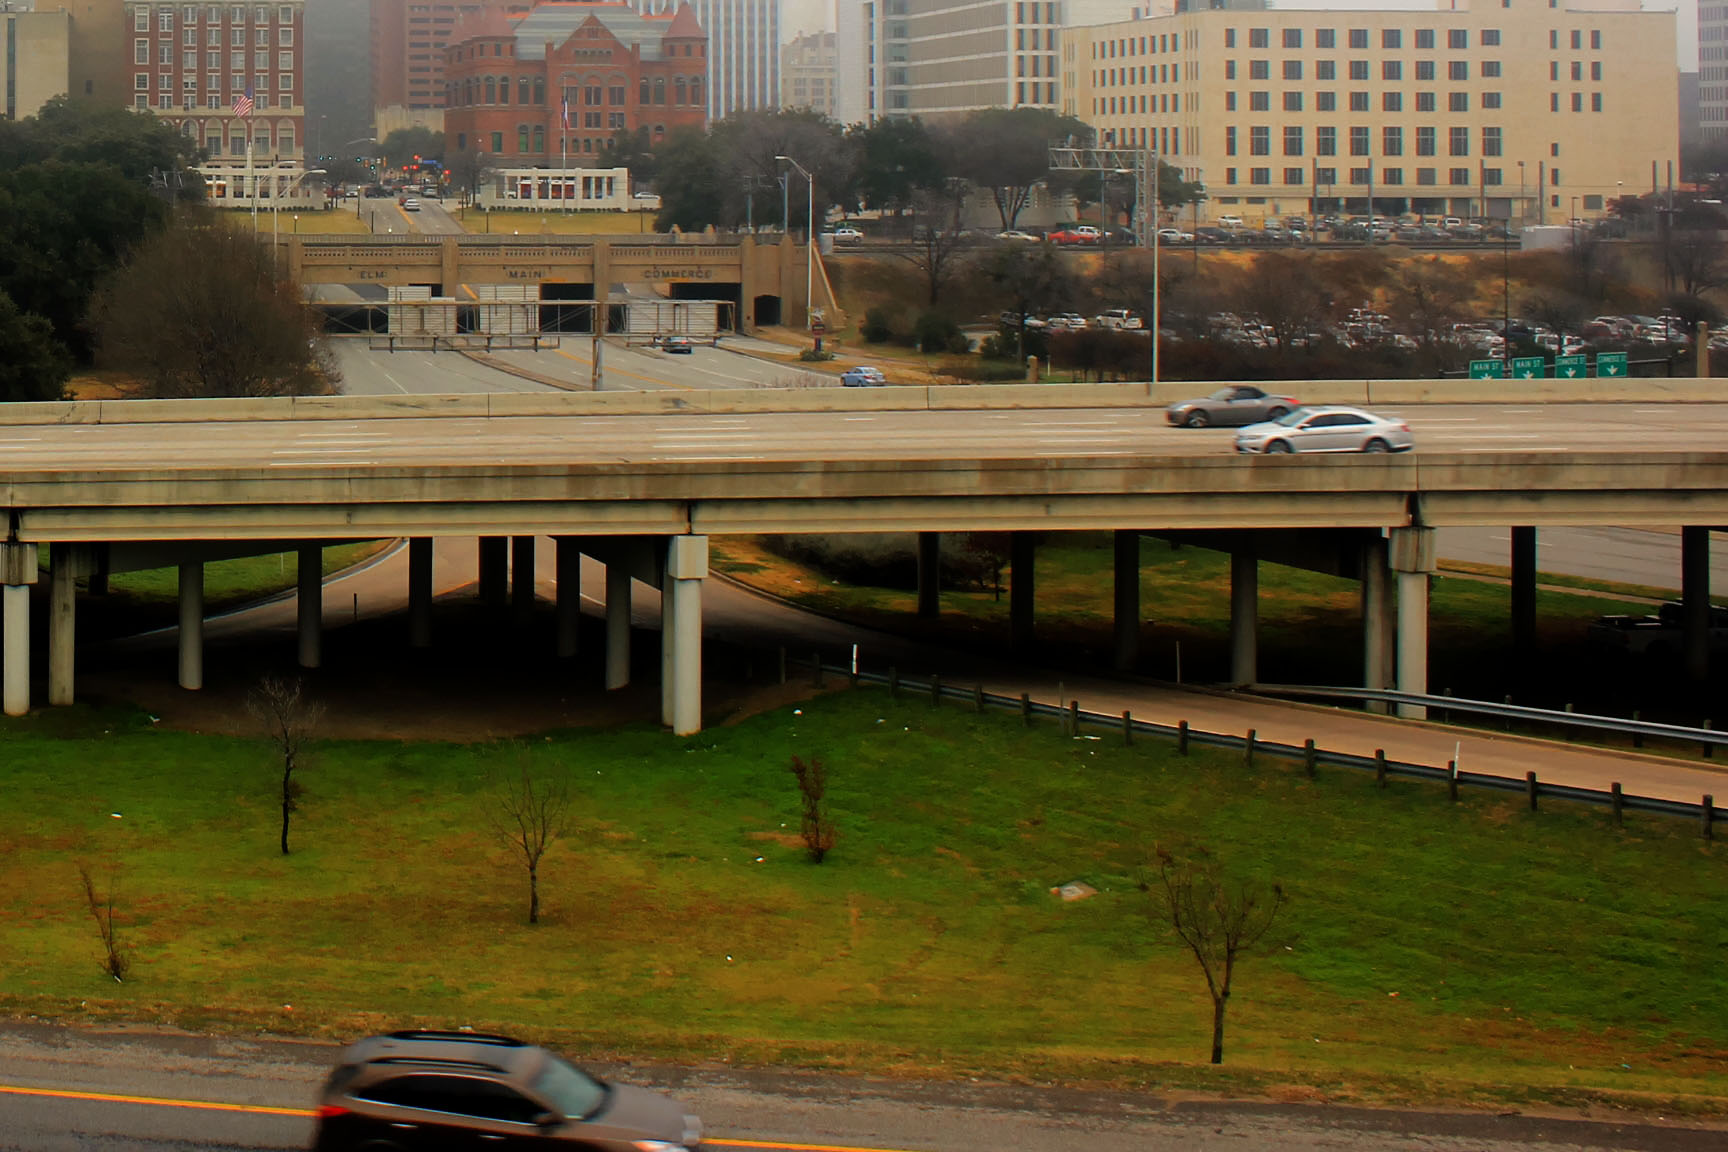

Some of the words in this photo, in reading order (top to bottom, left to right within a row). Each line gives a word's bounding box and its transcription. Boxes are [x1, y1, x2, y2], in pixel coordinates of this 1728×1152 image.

[360, 270, 385, 279] ELM
[508, 270, 542, 279] MAIN
[644, 270, 712, 279] COMMERCE
[1473, 362, 1490, 371] MAIN
[1515, 359, 1532, 368] MAIN
[1533, 359, 1541, 368] ST
